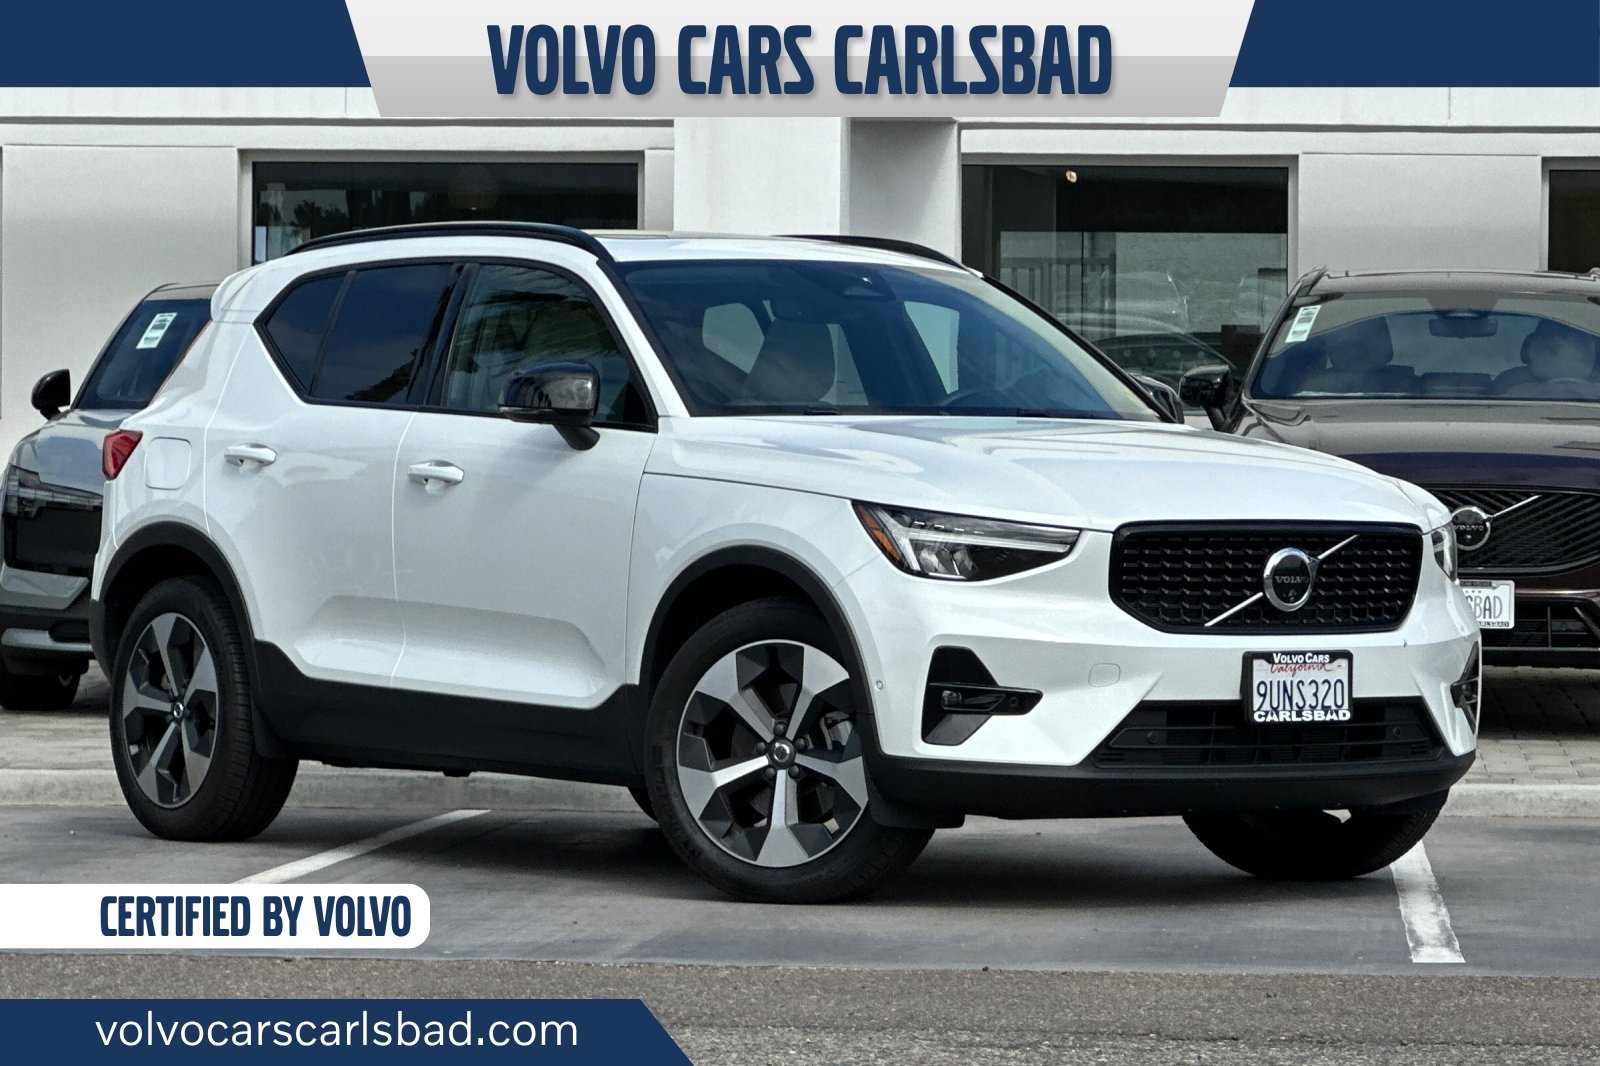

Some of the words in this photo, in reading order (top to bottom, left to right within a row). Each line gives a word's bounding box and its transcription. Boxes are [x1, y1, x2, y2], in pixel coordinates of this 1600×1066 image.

[1274, 575, 1309, 584] VOLVO
[1270, 662, 1330, 677] California
[1256, 678, 1345, 711] 9UNS320
[1253, 710, 1351, 722] CARLSBAD
